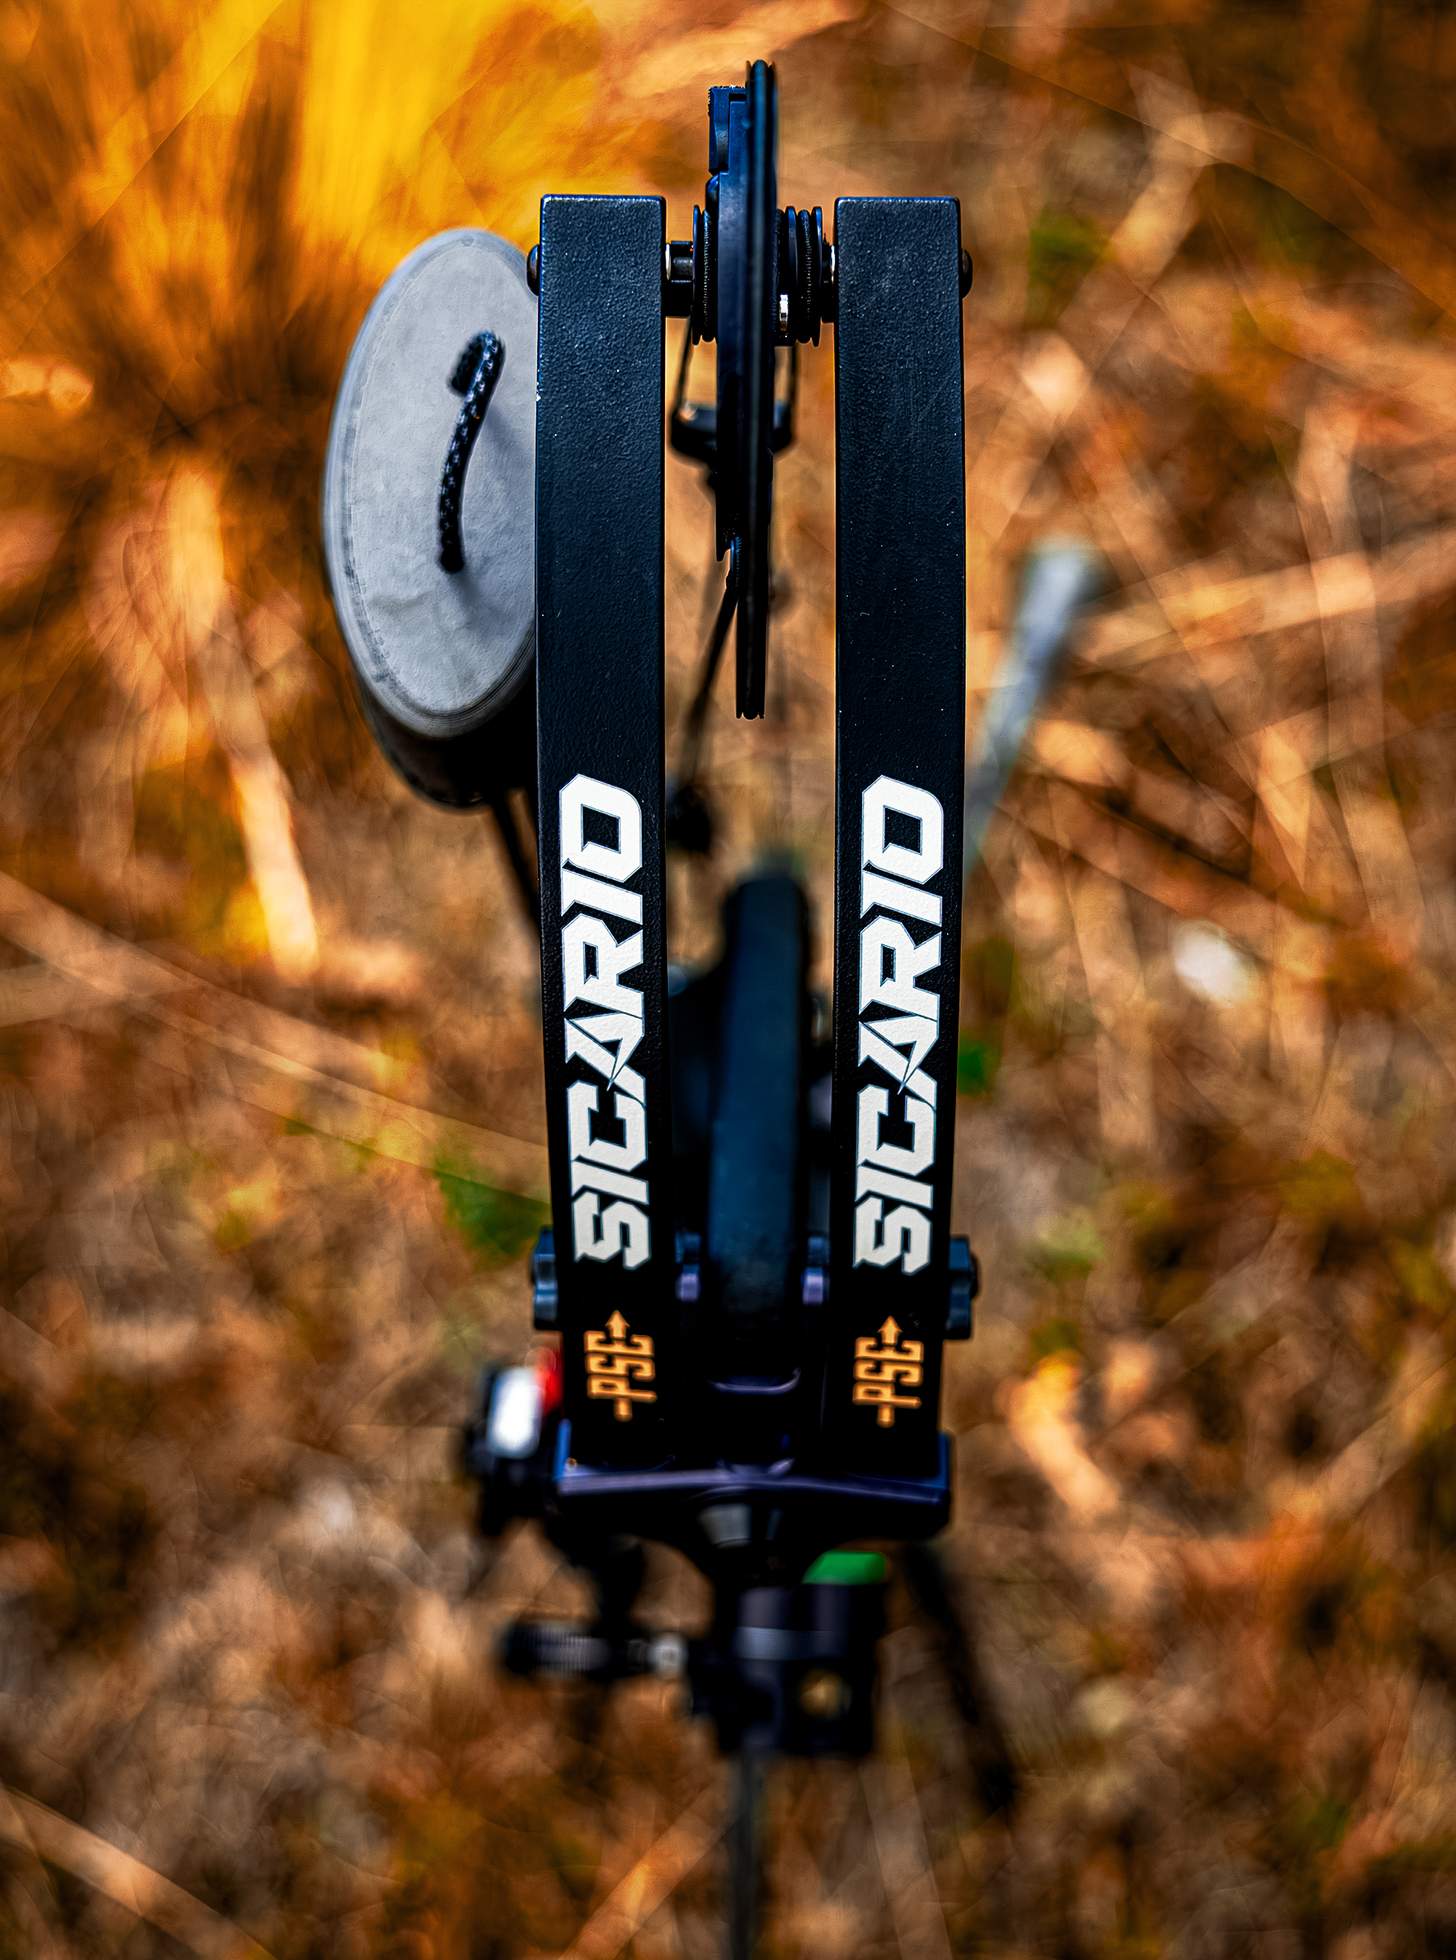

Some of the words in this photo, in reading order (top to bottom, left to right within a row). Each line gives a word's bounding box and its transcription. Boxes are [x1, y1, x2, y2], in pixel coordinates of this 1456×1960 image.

[558, 774, 650, 1269] SICARIO
[852, 774, 945, 1273] SICARIO
[584, 1329, 657, 1404] PSE
[852, 1335, 924, 1410] PSE
